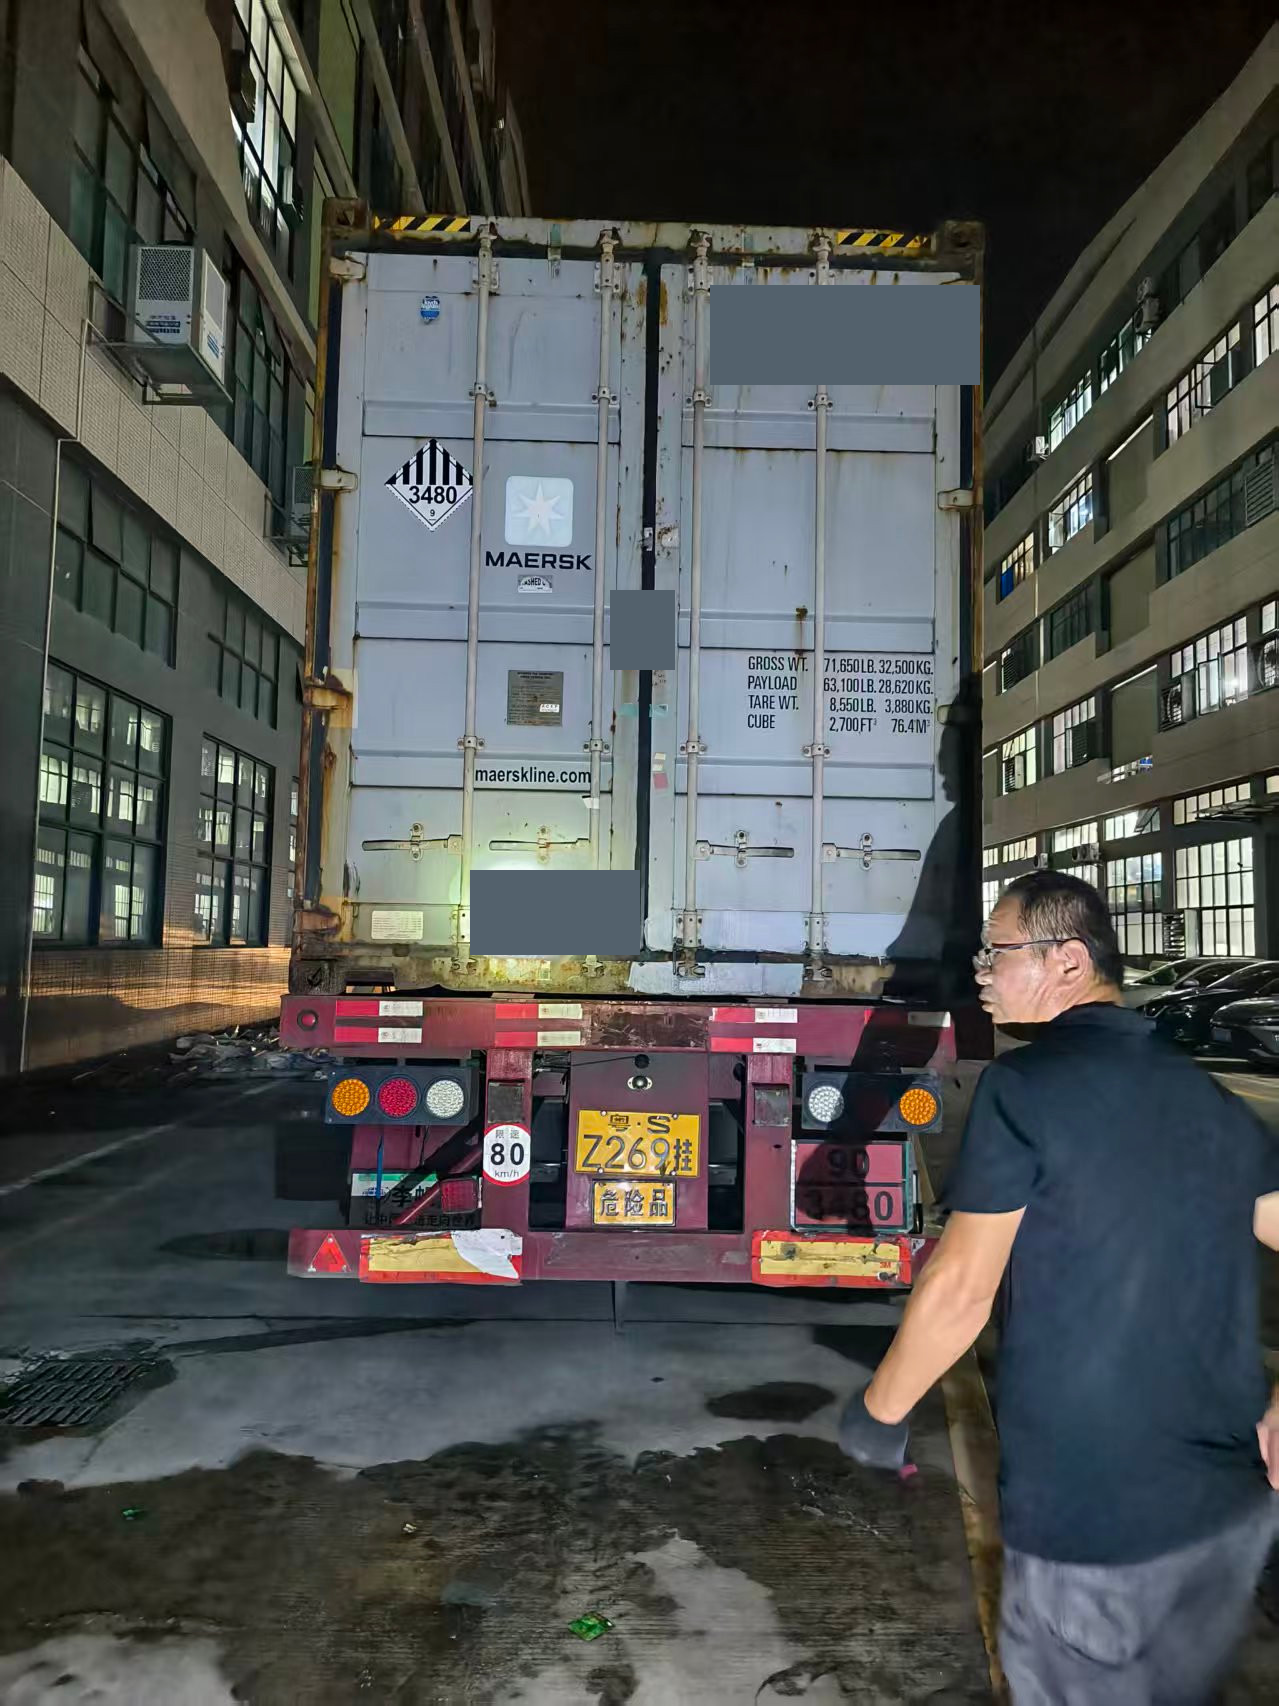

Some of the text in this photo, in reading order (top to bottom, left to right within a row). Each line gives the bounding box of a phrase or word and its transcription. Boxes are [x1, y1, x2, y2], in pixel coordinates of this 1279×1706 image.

[408, 486, 458, 505] 3480
[429, 509, 436, 517] 9
[485, 551, 592, 570] MAERSK
[748, 656, 785, 672] GROSS
[788, 657, 808, 672] WT.
[747, 675, 797, 691] PAYLOAD
[748, 695, 776, 710] TARE
[779, 696, 799, 711] WT.
[747, 714, 776, 729] CUBE
[475, 766, 591, 784] maerskline.com
[495, 1129, 520, 1139] 限速
[490, 1143, 525, 1166] 80
[582, 1135, 693, 1172] Z269挂
[494, 1170, 519, 1178] km/h
[600, 1189, 669, 1217] 危险品
